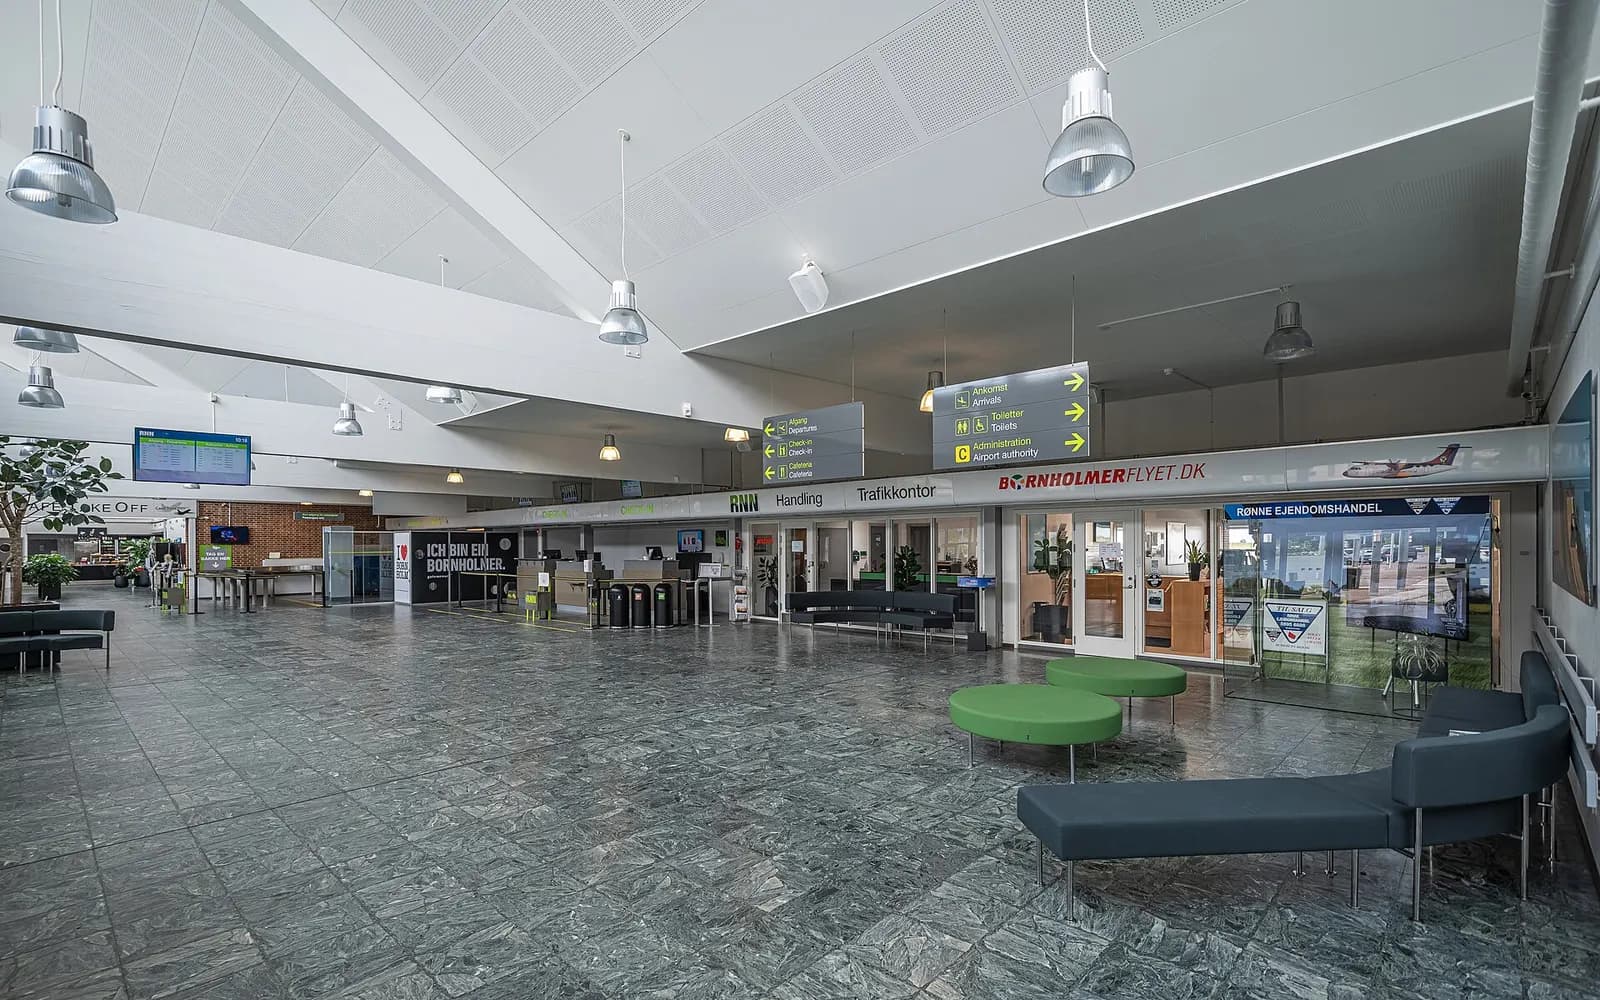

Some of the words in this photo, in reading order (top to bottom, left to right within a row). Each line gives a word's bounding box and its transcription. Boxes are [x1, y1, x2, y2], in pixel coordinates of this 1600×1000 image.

[972, 384, 1008, 396] Ankomst
[972, 395, 1002, 407] Arrivals
[992, 410, 1024, 421] Toiletter
[789, 426, 817, 434] Departures
[991, 422, 1018, 432] Toilets
[973, 438, 1031, 450] Administration
[789, 448, 813, 456] Check-in
[958, 447, 967, 461] C
[973, 452, 1000, 462] Airport
[1002, 448, 1039, 460] authority
[857, 484, 936, 502] Trafikkontor
[115, 501, 148, 513] OFF
[730, 493, 759, 512] RNN
[776, 493, 823, 508] Handling
[1236, 506, 1273, 517] RØNNE
[1275, 503, 1382, 516] EJENDOMSHANDEL
[427, 543, 446, 557] ICH
[449, 543, 468, 556] BIN
[471, 543, 489, 556] EIN
